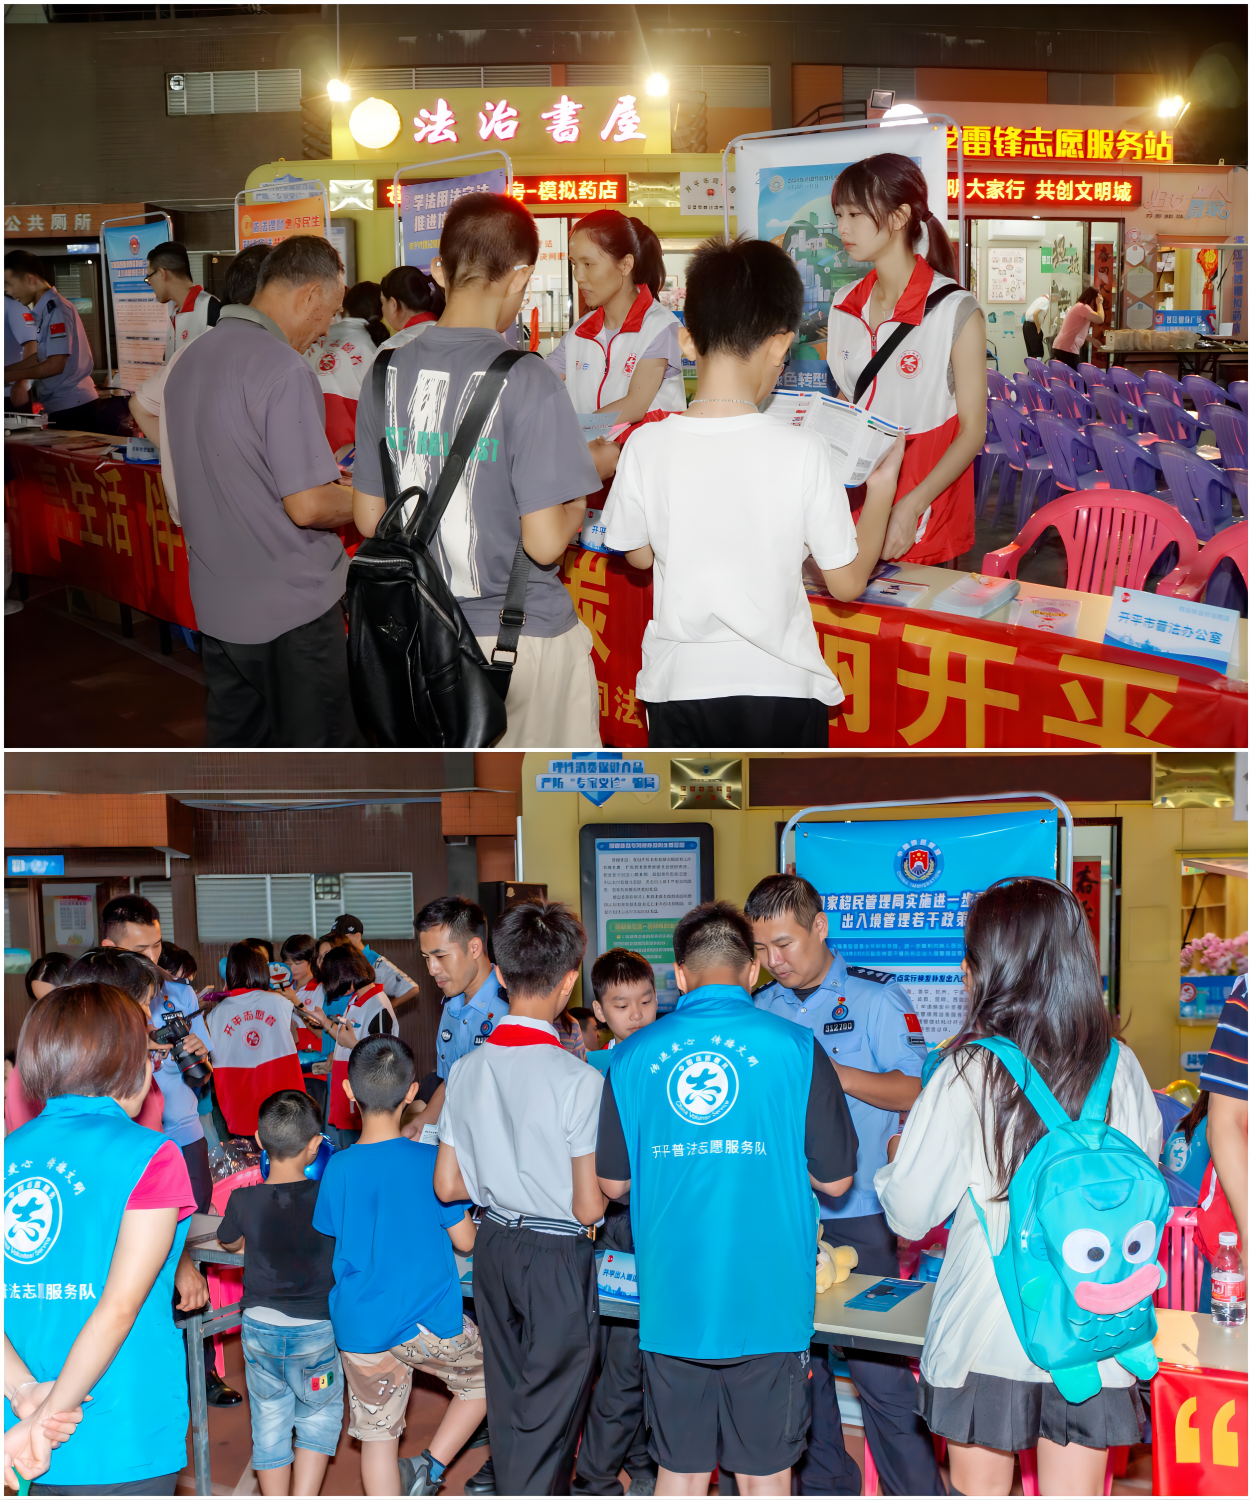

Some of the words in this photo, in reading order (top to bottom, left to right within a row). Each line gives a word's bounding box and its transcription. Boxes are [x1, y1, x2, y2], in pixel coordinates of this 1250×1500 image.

[413, 94, 648, 144] 法治書屋
[966, 178, 1025, 200] 大家行
[1035, 180, 1132, 202] 共创文明城
[5, 212, 92, 232] 公共厕所
[4, 1282, 97, 1301] 法志服务队
